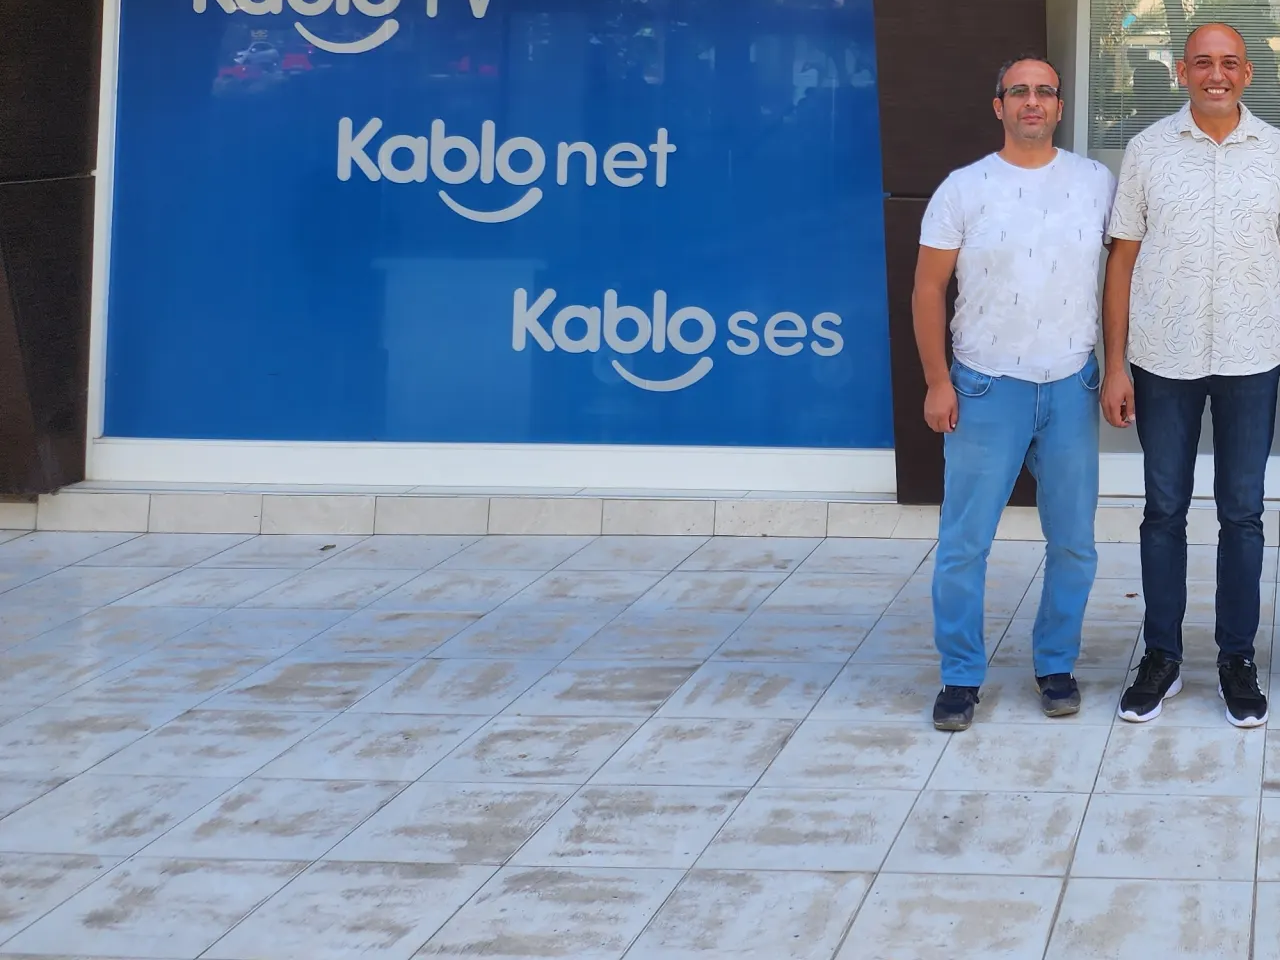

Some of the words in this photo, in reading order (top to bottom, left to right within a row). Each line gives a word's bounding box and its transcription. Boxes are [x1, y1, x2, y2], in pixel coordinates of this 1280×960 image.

[337, 116, 546, 186] Kablo
[557, 127, 677, 188] net
[512, 287, 716, 355] Kablo
[726, 310, 844, 357] ses
